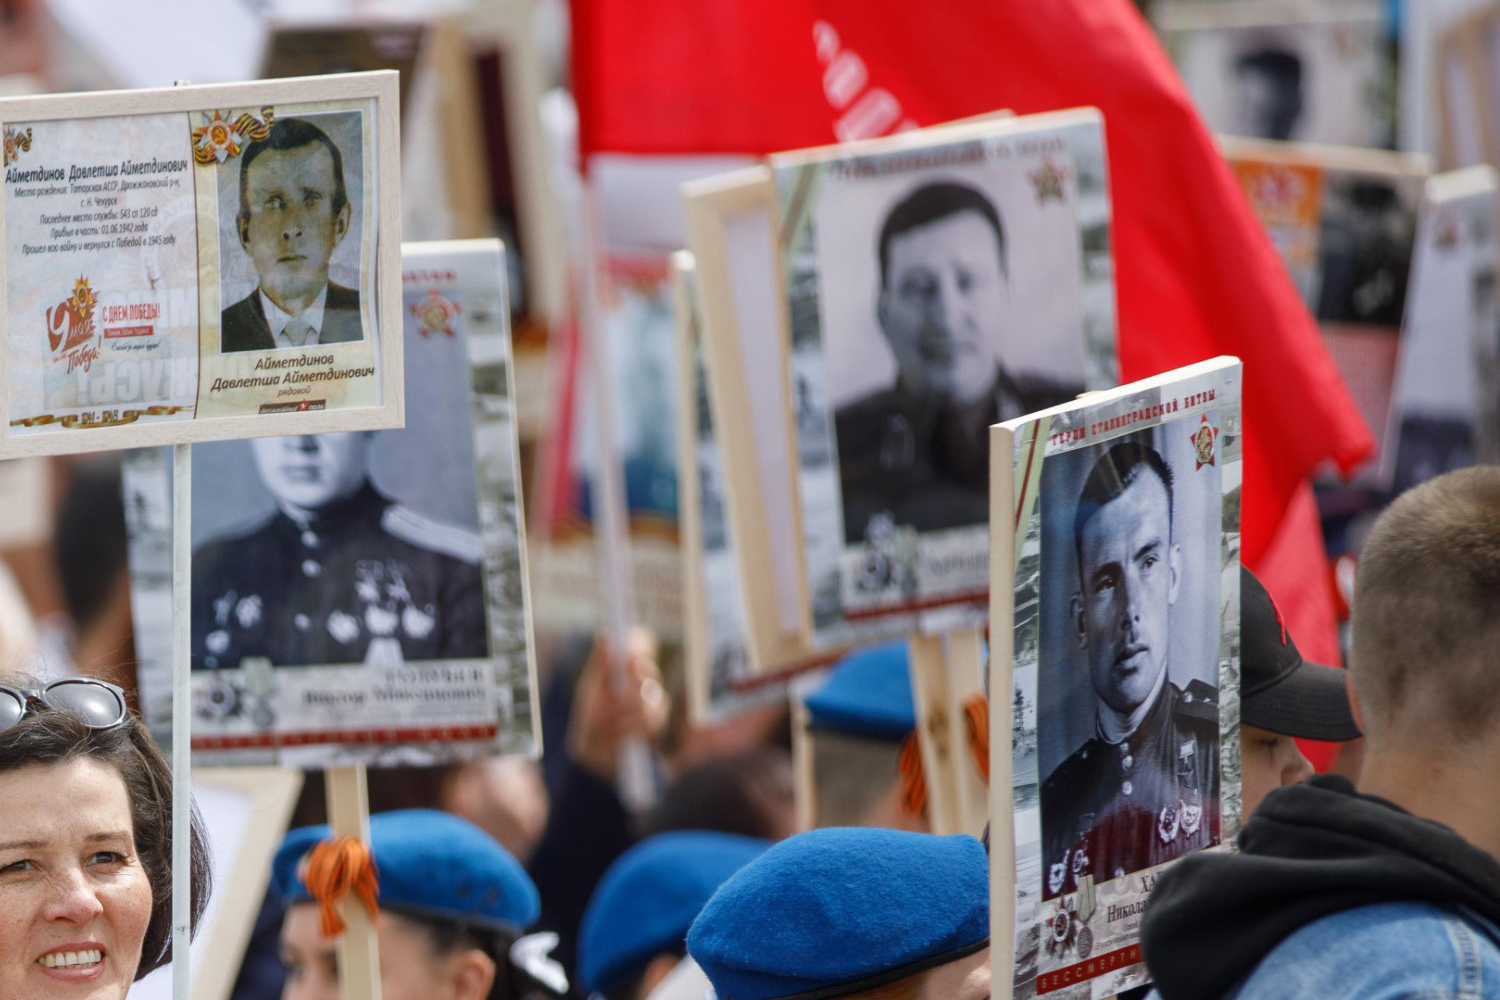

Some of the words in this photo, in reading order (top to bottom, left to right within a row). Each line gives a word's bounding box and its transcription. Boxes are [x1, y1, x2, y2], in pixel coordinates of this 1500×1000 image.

[5, 165, 65, 184] Айметдинов
[69, 162, 118, 183] Давлетша
[120, 157, 188, 175] Айметдинович
[14, 187, 36, 198] Место
[36, 184, 69, 197] рождения:
[70, 182, 102, 194] Татарская
[120, 177, 169, 192] Дрожжановский
[40, 212, 72, 225] Последнее
[72, 213, 93, 223] место
[93, 210, 118, 223] службы:
[120, 208, 131, 219] 543
[139, 207, 150, 217] 120
[50, 227, 75, 241] Прибыл
[79, 226, 100, 237] часть:
[101, 223, 134, 235] 01.06.1942
[134, 222, 149, 233] года
[22, 243, 47, 257] Прошел
[47, 243, 60, 253] всю
[60, 241, 77, 254] войну
[78, 241, 83, 251] и
[83, 240, 111, 254] вернулся
[115, 236, 142, 249] Победой
[147, 235, 163, 247] 1945
[163, 234, 176, 247] году
[102, 305, 108, 321] С
[108, 304, 128, 324] ДНЕМ
[129, 302, 161, 322] ПОБЕДЫ!
[50, 300, 71, 352] 9
[255, 353, 334, 371] Айметдинов
[210, 375, 280, 393] Давлетша
[282, 366, 375, 385] Айметдинович
[277, 386, 311, 398] рядовой
[1052, 427, 1086, 446] ГЕРОИ
[1091, 398, 1179, 436] СТАЛИНГРАДСКОЙ
[1184, 389, 1216, 409] БИТВЫ
[1041, 948, 1137, 989] БЕССМЕРТН
